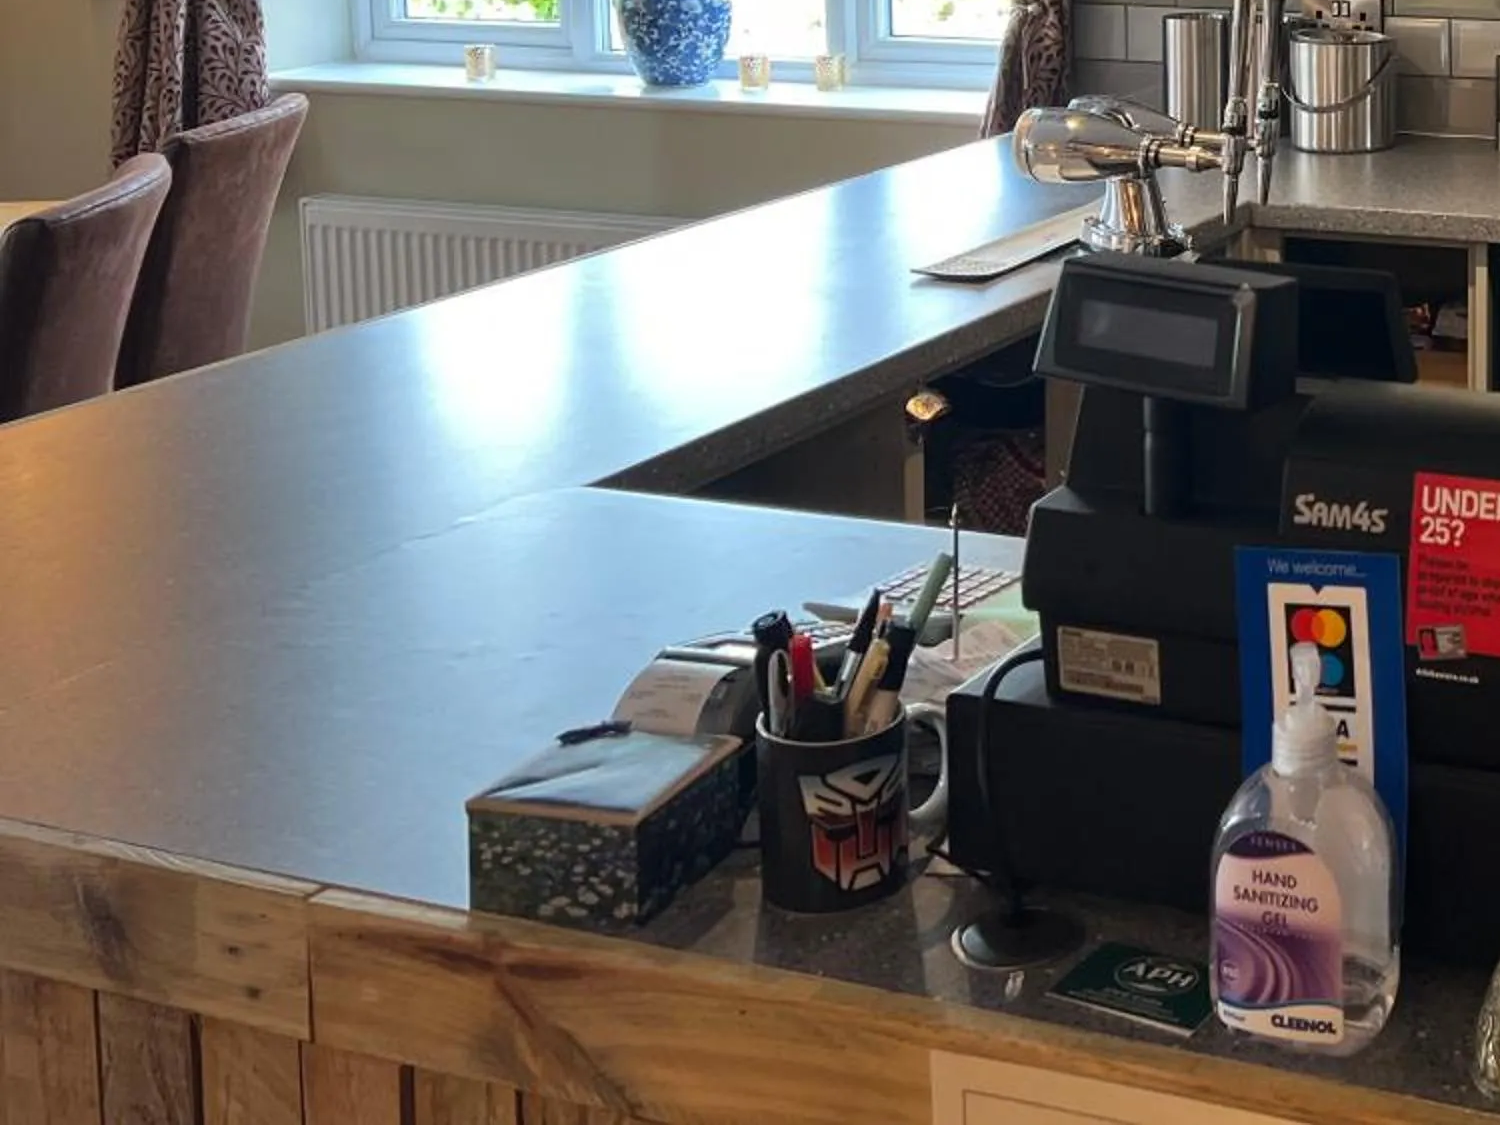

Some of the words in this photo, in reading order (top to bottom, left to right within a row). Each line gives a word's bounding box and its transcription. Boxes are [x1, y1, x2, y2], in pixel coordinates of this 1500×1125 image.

[1419, 517, 1465, 547] 25?
[1267, 558, 1289, 574] We
[1252, 870, 1297, 889] HAND
[1233, 885, 1319, 914] SANITIZING
[1261, 911, 1288, 926] GEL
[1122, 962, 1194, 988] APH
[1270, 1014, 1337, 1035] CLEENOL
